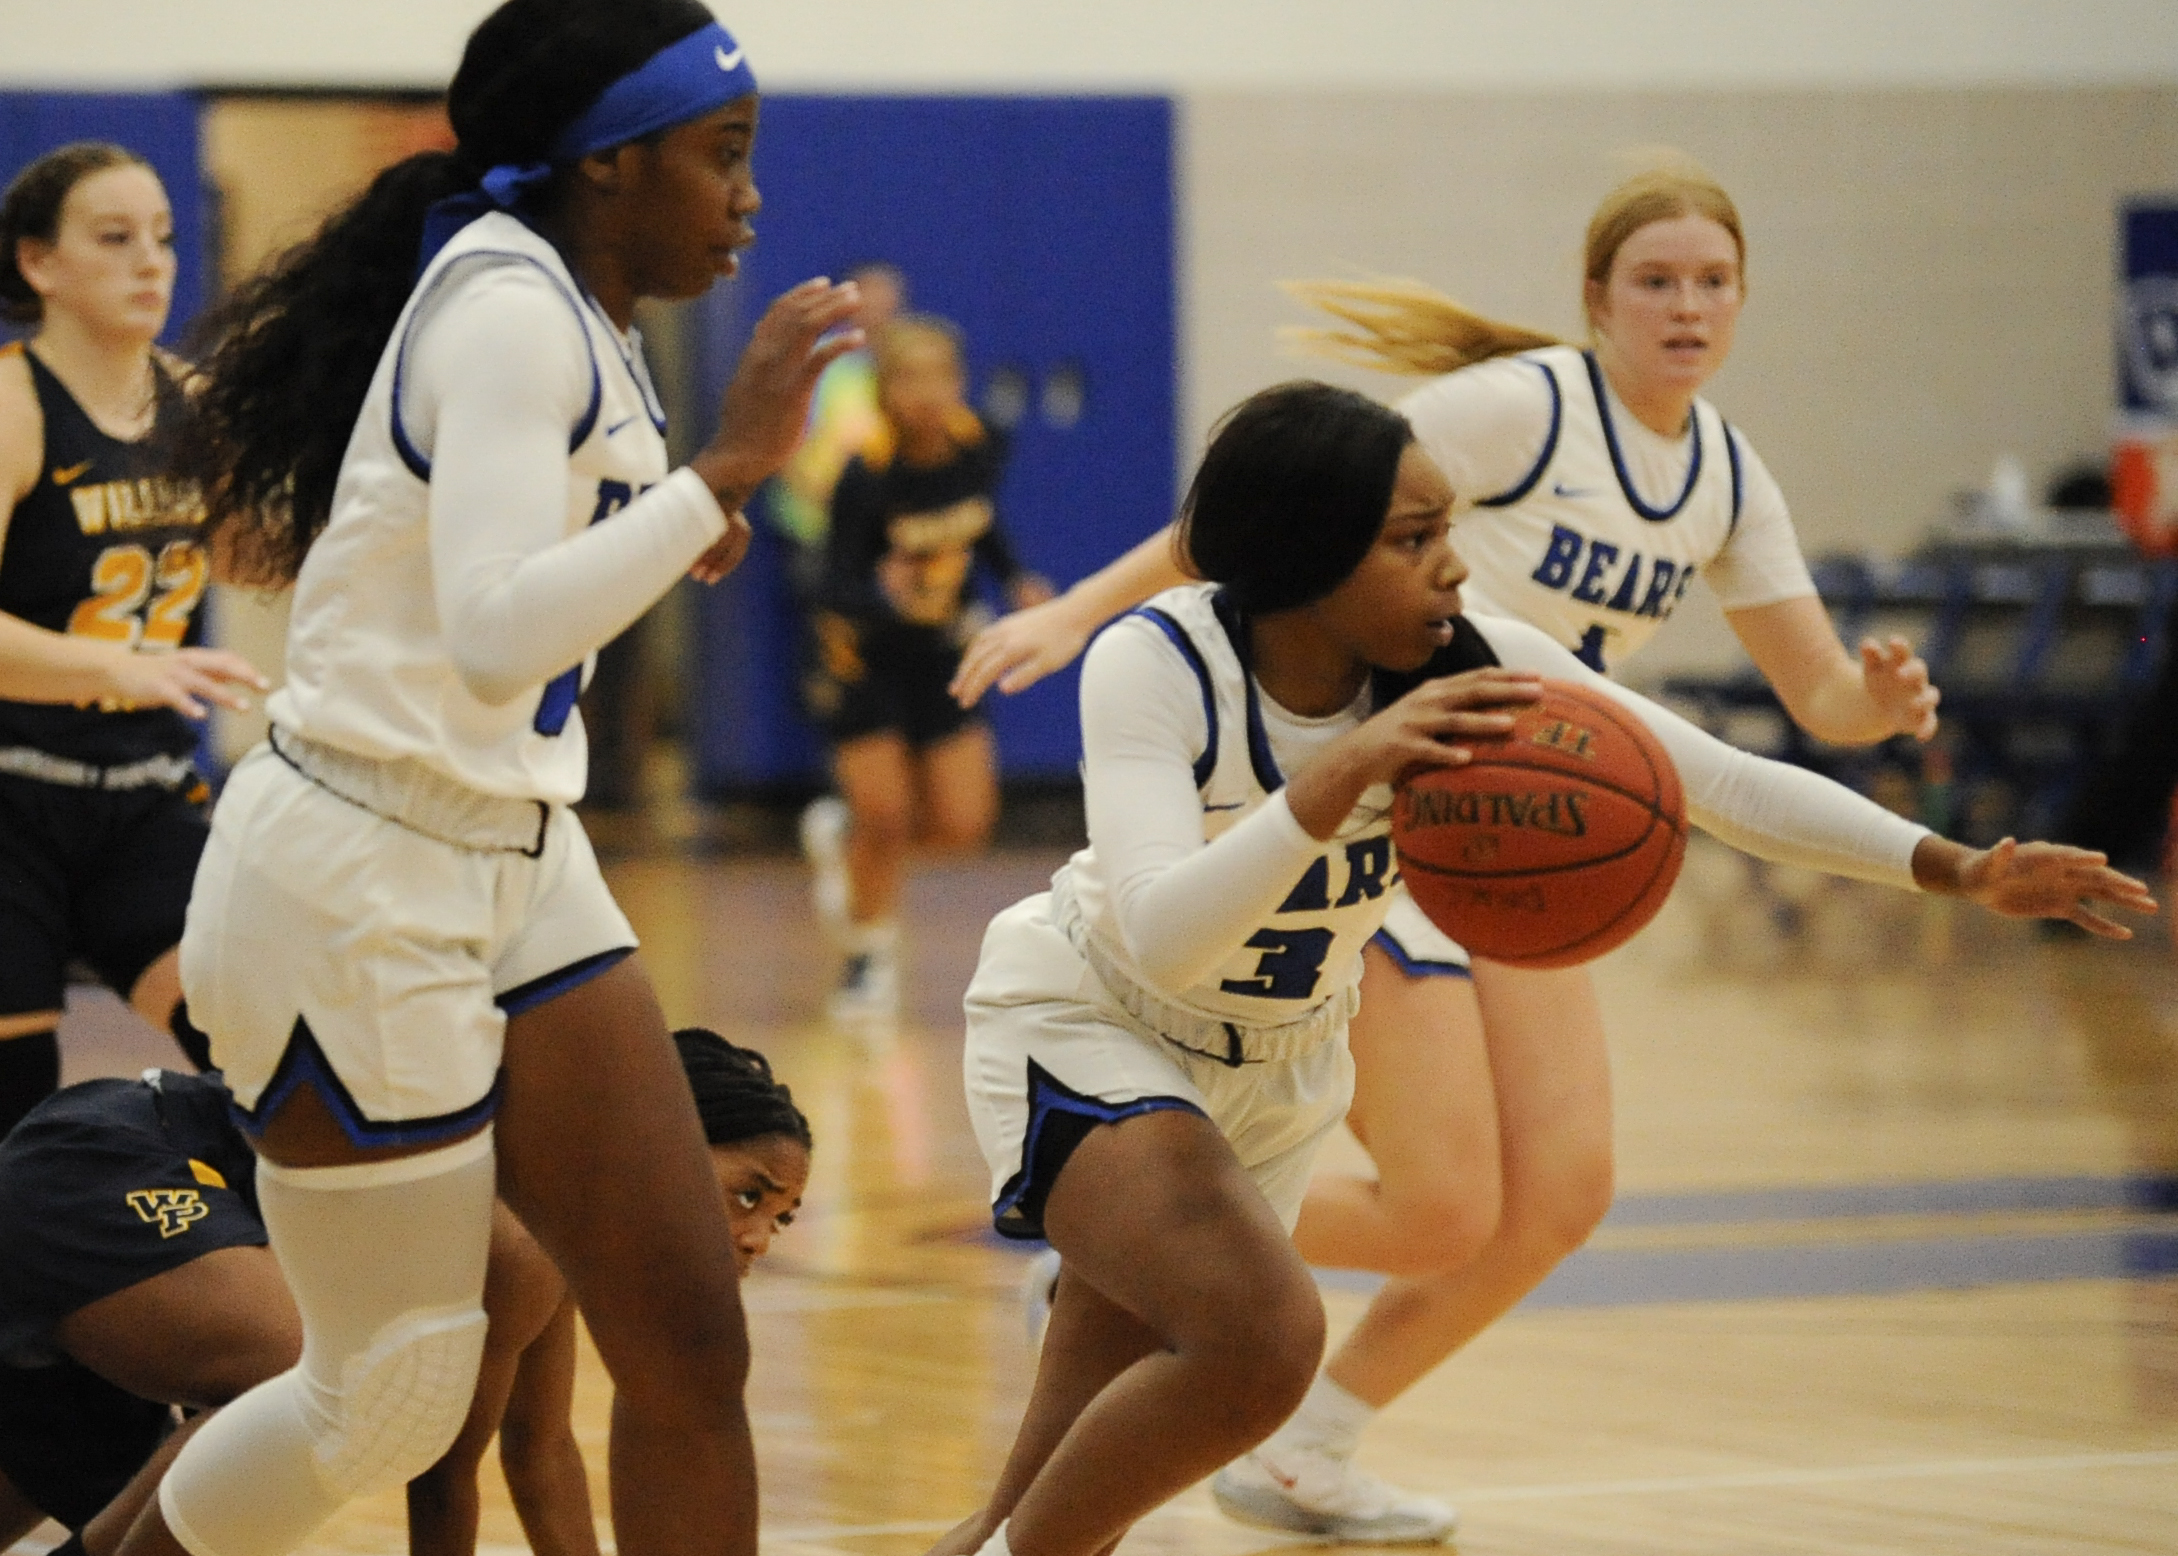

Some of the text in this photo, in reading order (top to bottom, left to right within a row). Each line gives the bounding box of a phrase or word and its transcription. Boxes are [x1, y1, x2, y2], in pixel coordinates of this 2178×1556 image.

[68, 540, 209, 655] 22
[1275, 835, 1400, 914] AR
[1220, 926, 1336, 1000] 3
